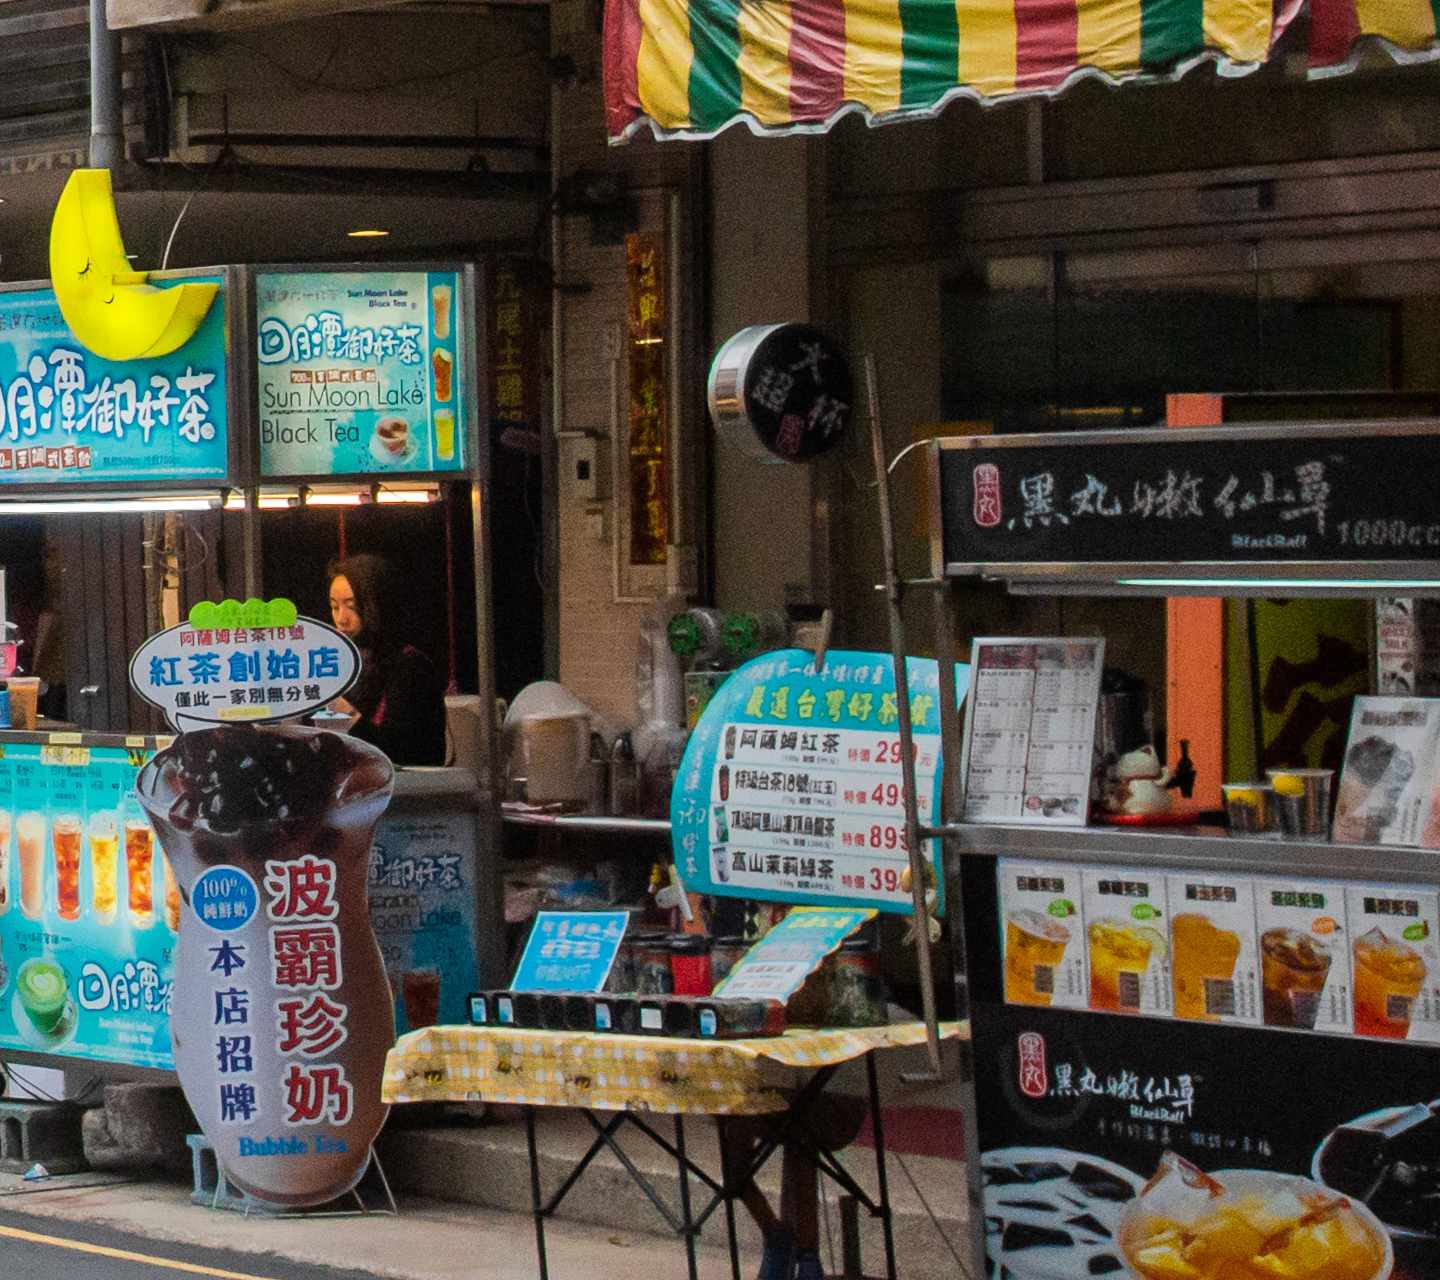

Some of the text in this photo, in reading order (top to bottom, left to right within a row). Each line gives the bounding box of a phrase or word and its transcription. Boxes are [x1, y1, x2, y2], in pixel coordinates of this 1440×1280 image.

[264, 379, 424, 408] Sun Moon Lake
[262, 417, 360, 444] Black Tea
[150, 646, 340, 687] 紅茶創始店
[175, 685, 321, 708] 僅此一家別無分號
[740, 729, 840, 754] 阿薩姆紅茶
[202, 878, 248, 898] 100%
[270, 858, 351, 1123] 波霸珍奶
[209, 940, 257, 1121] 本店招牌
[238, 1135, 348, 1157] Bubble Tea
